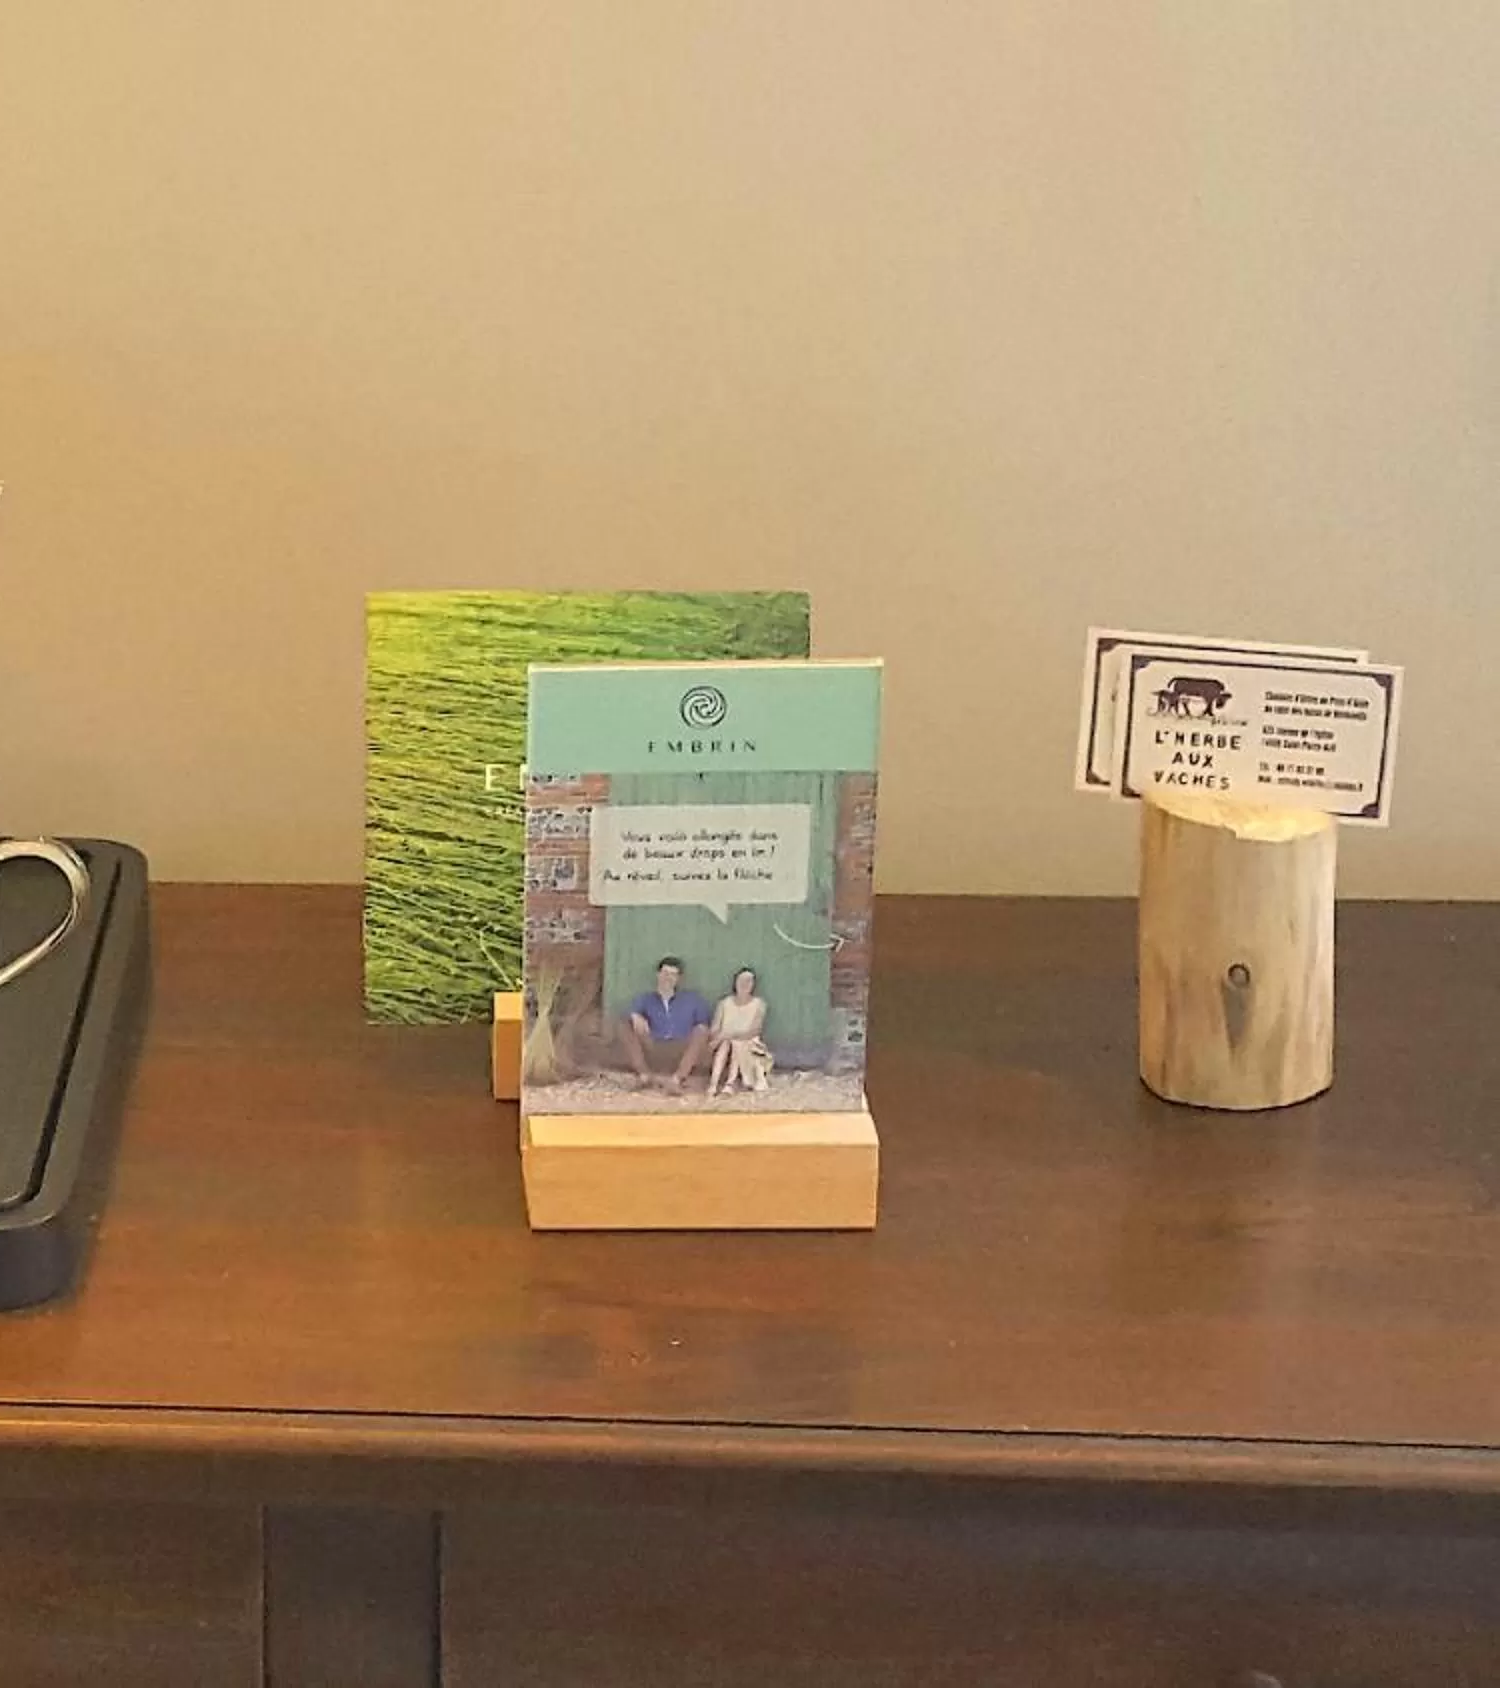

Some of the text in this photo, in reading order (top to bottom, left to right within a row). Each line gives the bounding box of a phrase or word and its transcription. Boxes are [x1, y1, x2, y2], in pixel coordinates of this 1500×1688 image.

[647, 739, 756, 754] EMBRIN
[1154, 729, 1242, 751] L'HERBE
[1171, 751, 1214, 769] AUX
[1153, 770, 1231, 791] VACHES
